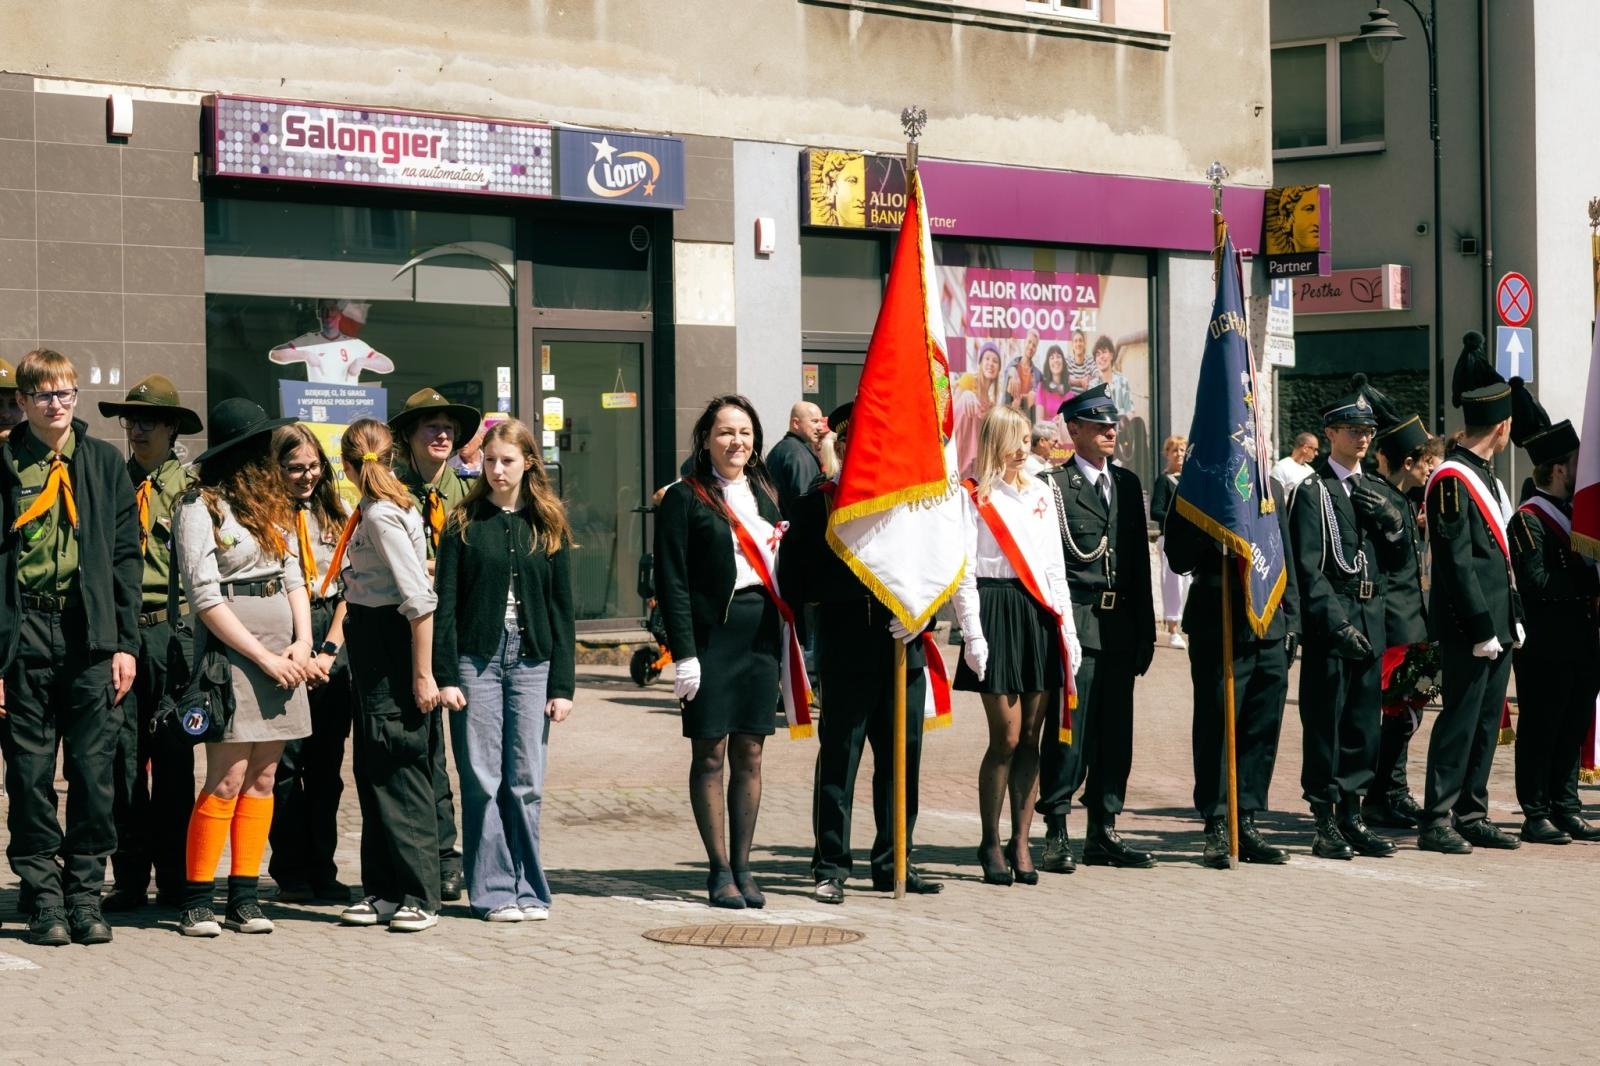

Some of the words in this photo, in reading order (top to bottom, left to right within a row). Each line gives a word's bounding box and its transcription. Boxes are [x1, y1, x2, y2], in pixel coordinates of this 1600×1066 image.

[286, 115, 377, 153] Salon
[381, 131, 443, 165] gier
[401, 167, 417, 177] na
[419, 165, 486, 183] automatach
[603, 160, 647, 188] LOTTO
[870, 208, 905, 225] BANK
[929, 216, 957, 228] rtner
[1269, 260, 1312, 273] Partner
[969, 280, 1017, 300] ALIOR
[1020, 282, 1073, 303] KONTO
[1076, 285, 1096, 304] ZA
[1301, 283, 1343, 301] Pestka
[969, 304, 1065, 331] ZEROOOO
[1070, 308, 1097, 332] ZŁ!
[334, 398, 355, 406] POLSKI
[356, 398, 375, 406] SPORT
